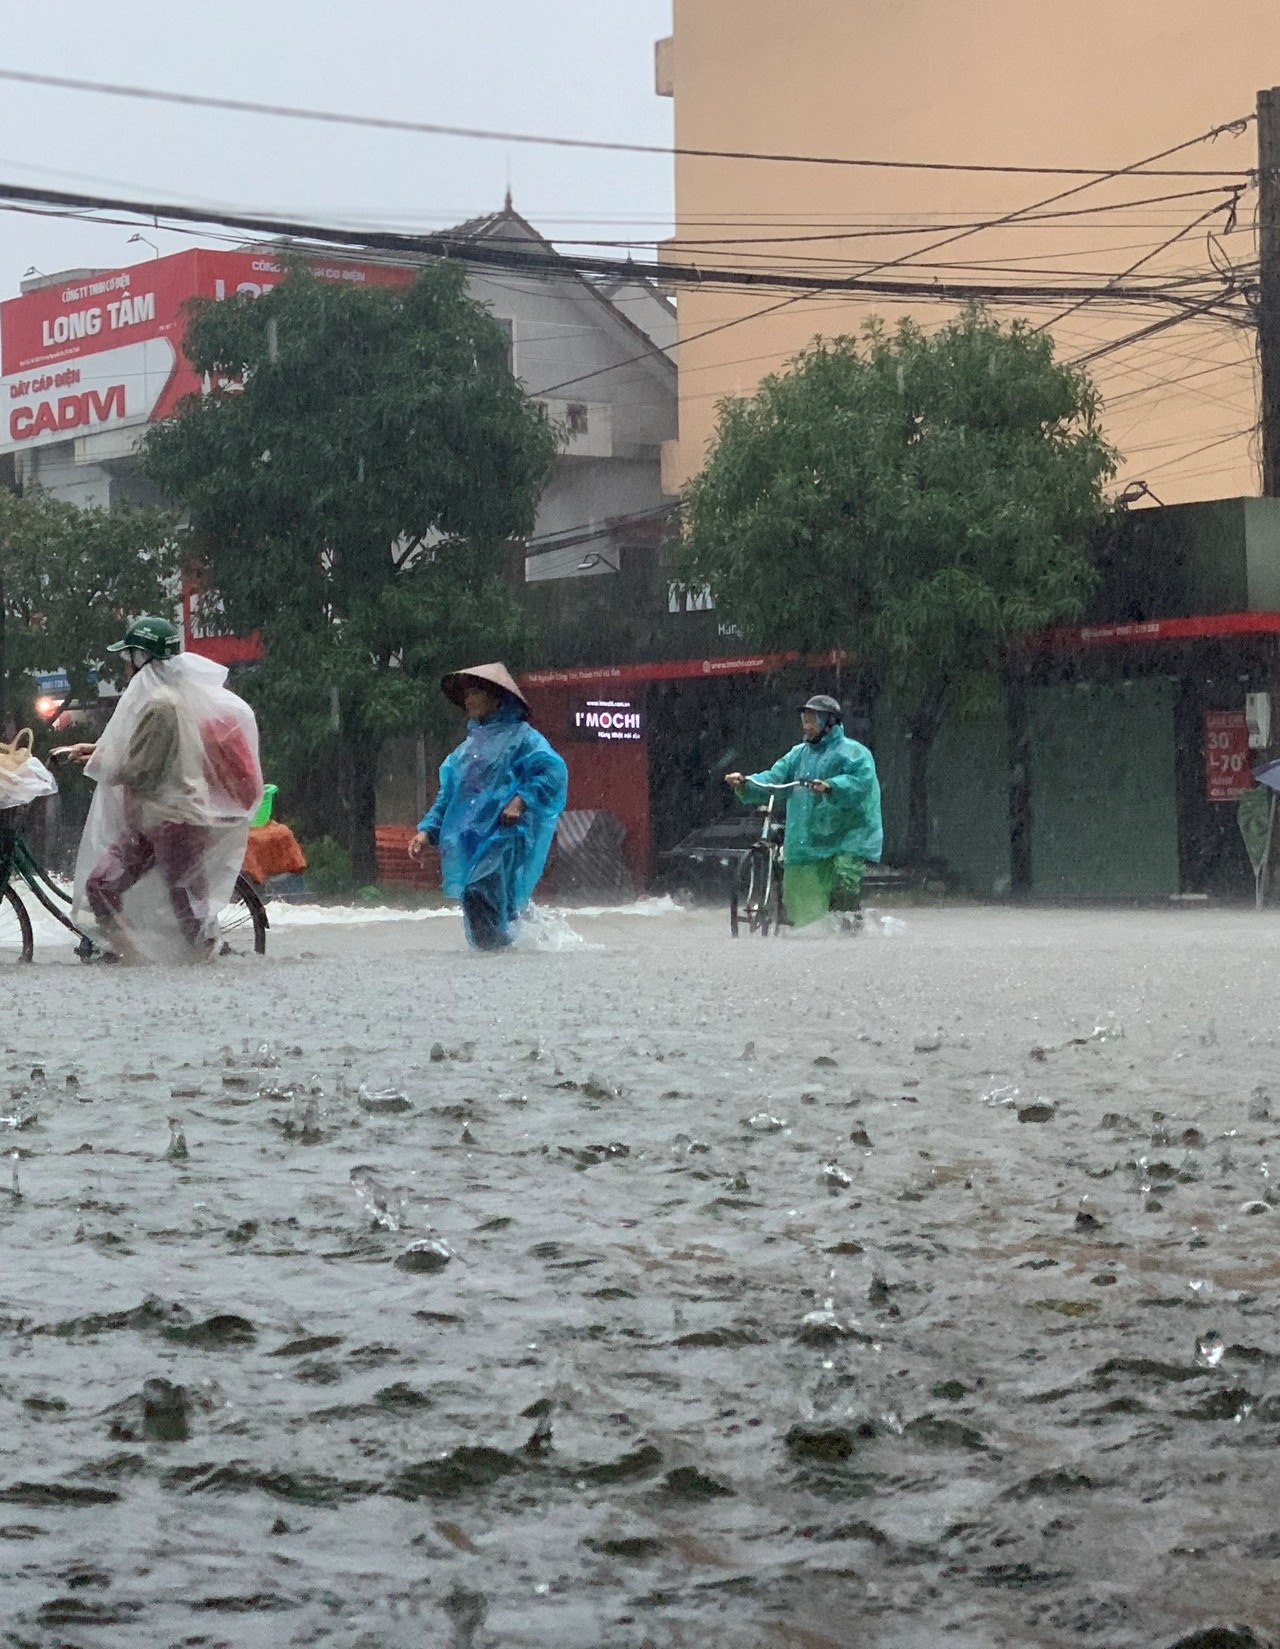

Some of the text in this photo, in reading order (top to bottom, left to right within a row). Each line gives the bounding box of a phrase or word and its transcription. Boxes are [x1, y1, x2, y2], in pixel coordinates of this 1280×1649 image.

[62, 287, 79, 303] CÔNG
[79, 286, 88, 299] TY
[89, 281, 105, 296] TNHH
[115, 273, 130, 290] ĐIỆN
[43, 291, 155, 347] LONG TÂM
[10, 368, 80, 399] DÂY CÁP ĐIỆN
[10, 384, 125, 441] CADIVI
